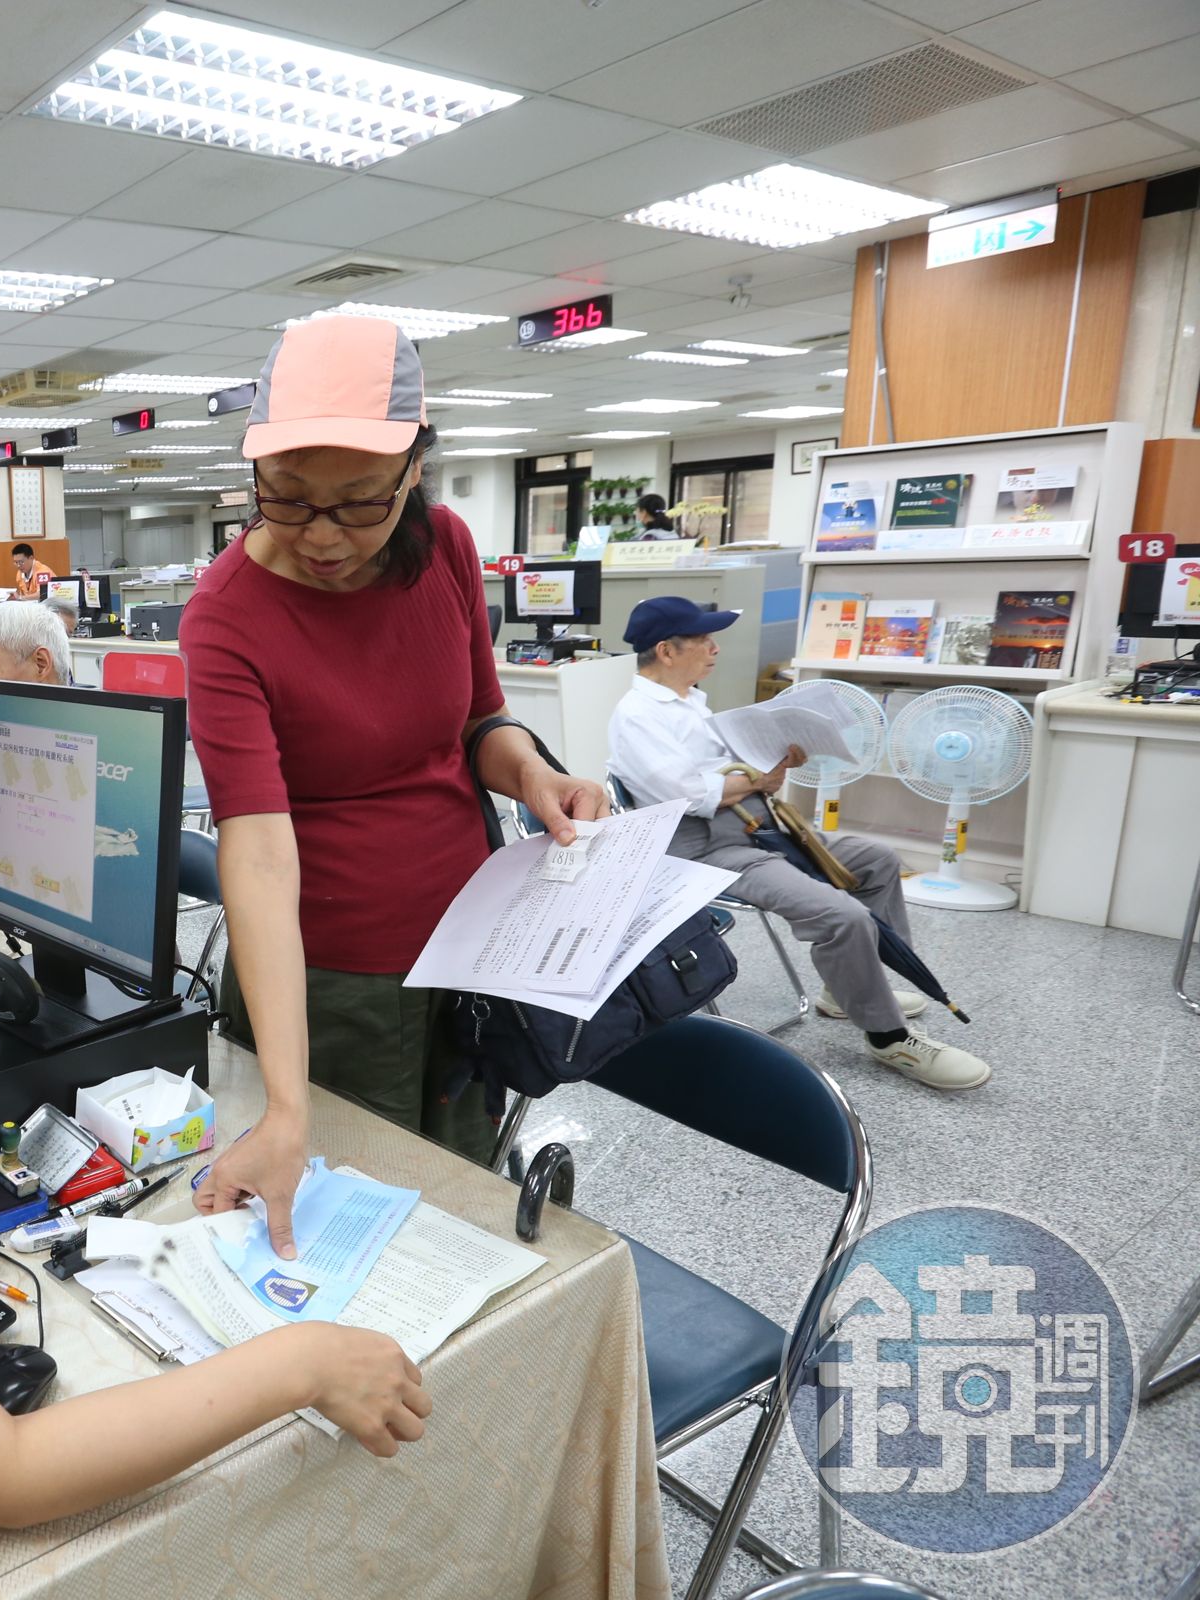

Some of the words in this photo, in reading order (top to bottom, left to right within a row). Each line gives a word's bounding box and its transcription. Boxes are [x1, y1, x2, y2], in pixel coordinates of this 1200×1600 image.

[552, 303, 602, 336] 366
[140, 411, 149, 430] 0
[5, 443, 12, 458] 0
[1127, 540, 1165, 557] 18
[502, 559, 520, 571] 19
[38, 574, 49, 583] 23
[96, 761, 134, 783] acer
[13, 926, 27, 936] acer
